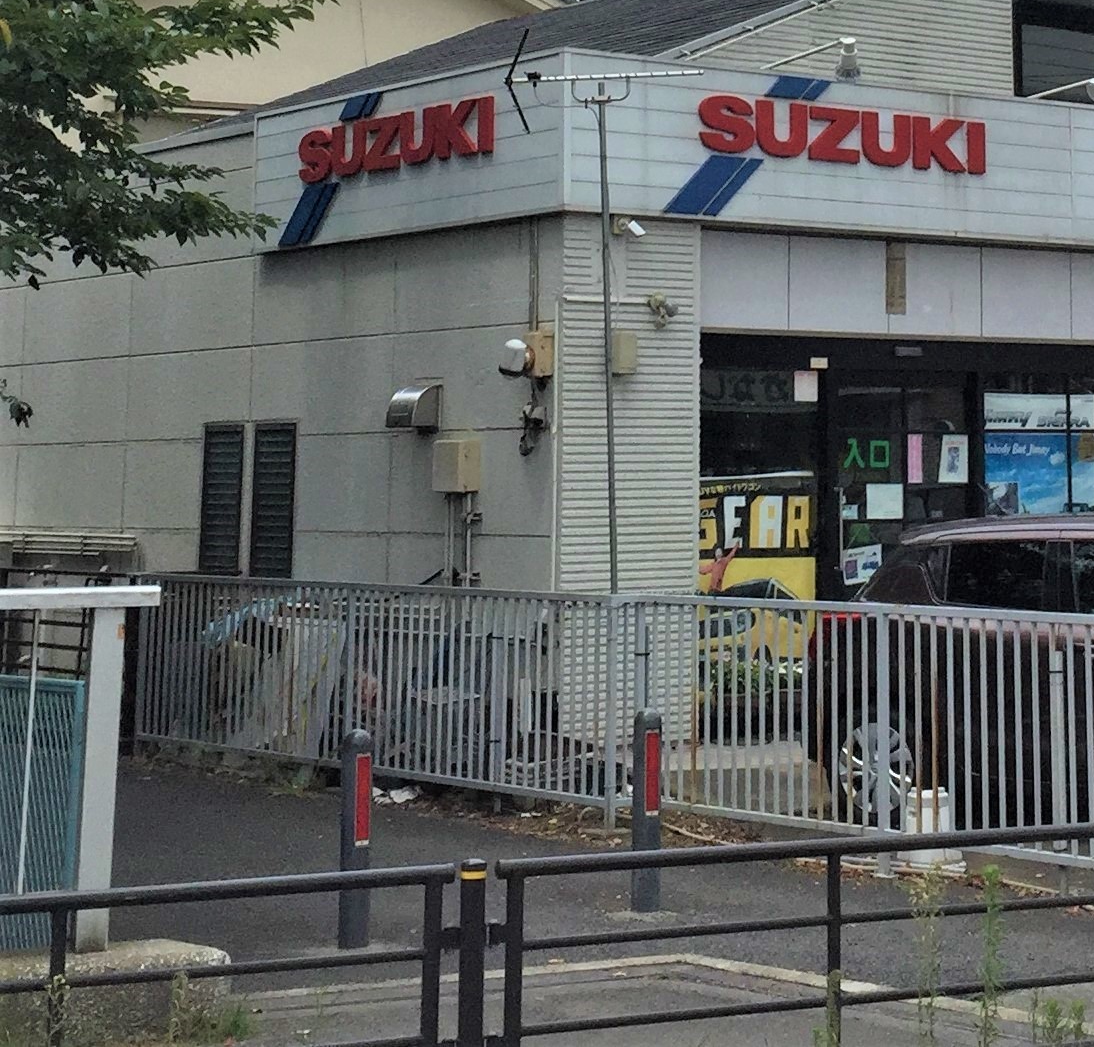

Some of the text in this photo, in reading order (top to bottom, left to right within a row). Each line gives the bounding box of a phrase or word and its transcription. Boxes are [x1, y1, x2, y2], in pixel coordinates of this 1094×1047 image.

[298, 95, 495, 184] SUZUKI
[699, 95, 987, 175] SUZUKI
[844, 438, 890, 468] 入口
